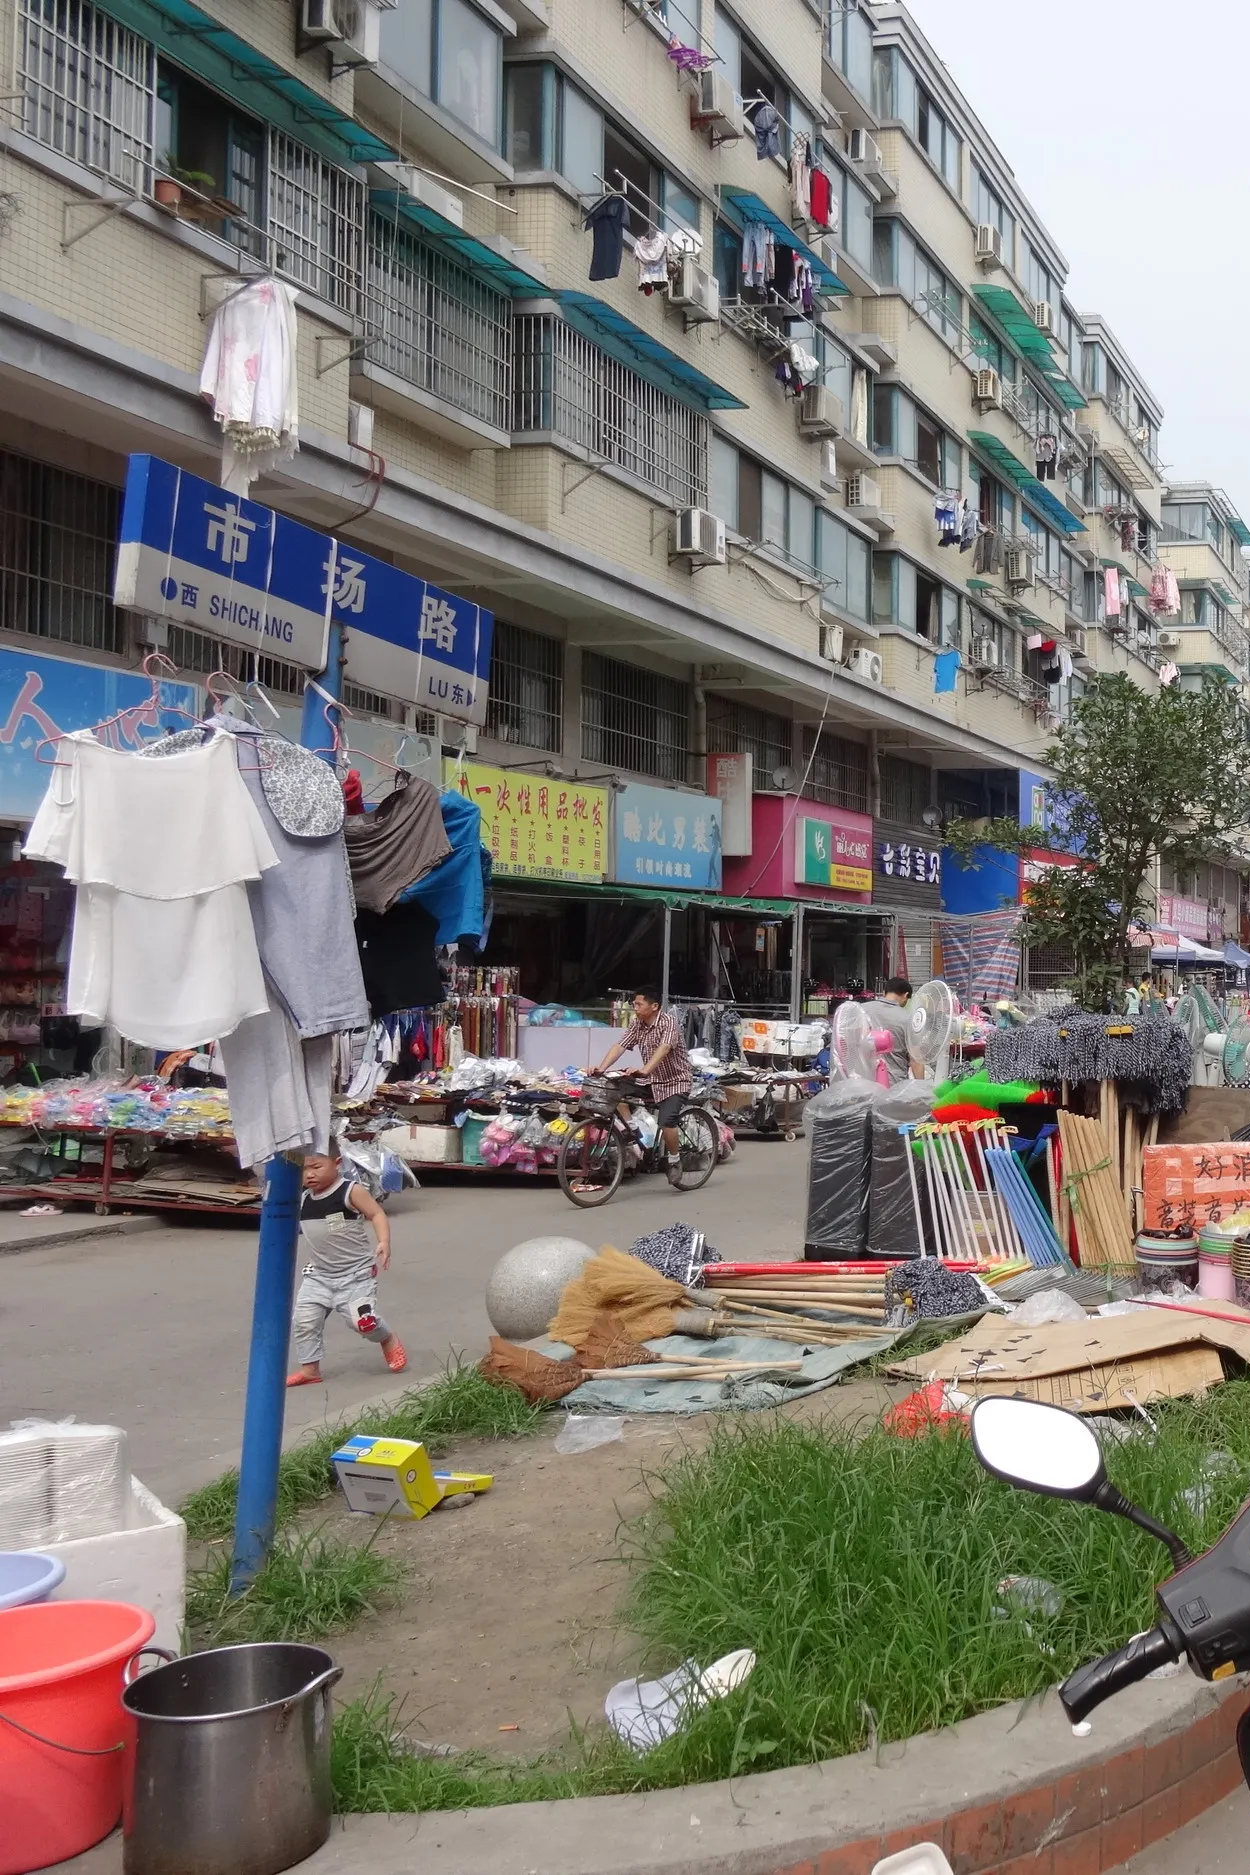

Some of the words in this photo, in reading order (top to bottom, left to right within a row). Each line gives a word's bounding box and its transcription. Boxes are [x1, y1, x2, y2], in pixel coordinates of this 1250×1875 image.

[204, 502, 458, 653] 市场路
[180, 581, 198, 610] 西
[210, 594, 294, 643] SHICHANG
[428, 675, 449, 699] LU
[451, 683, 464, 705] 东
[528, 829, 536, 864] 打火机
[622, 806, 710, 853] 酷比男装
